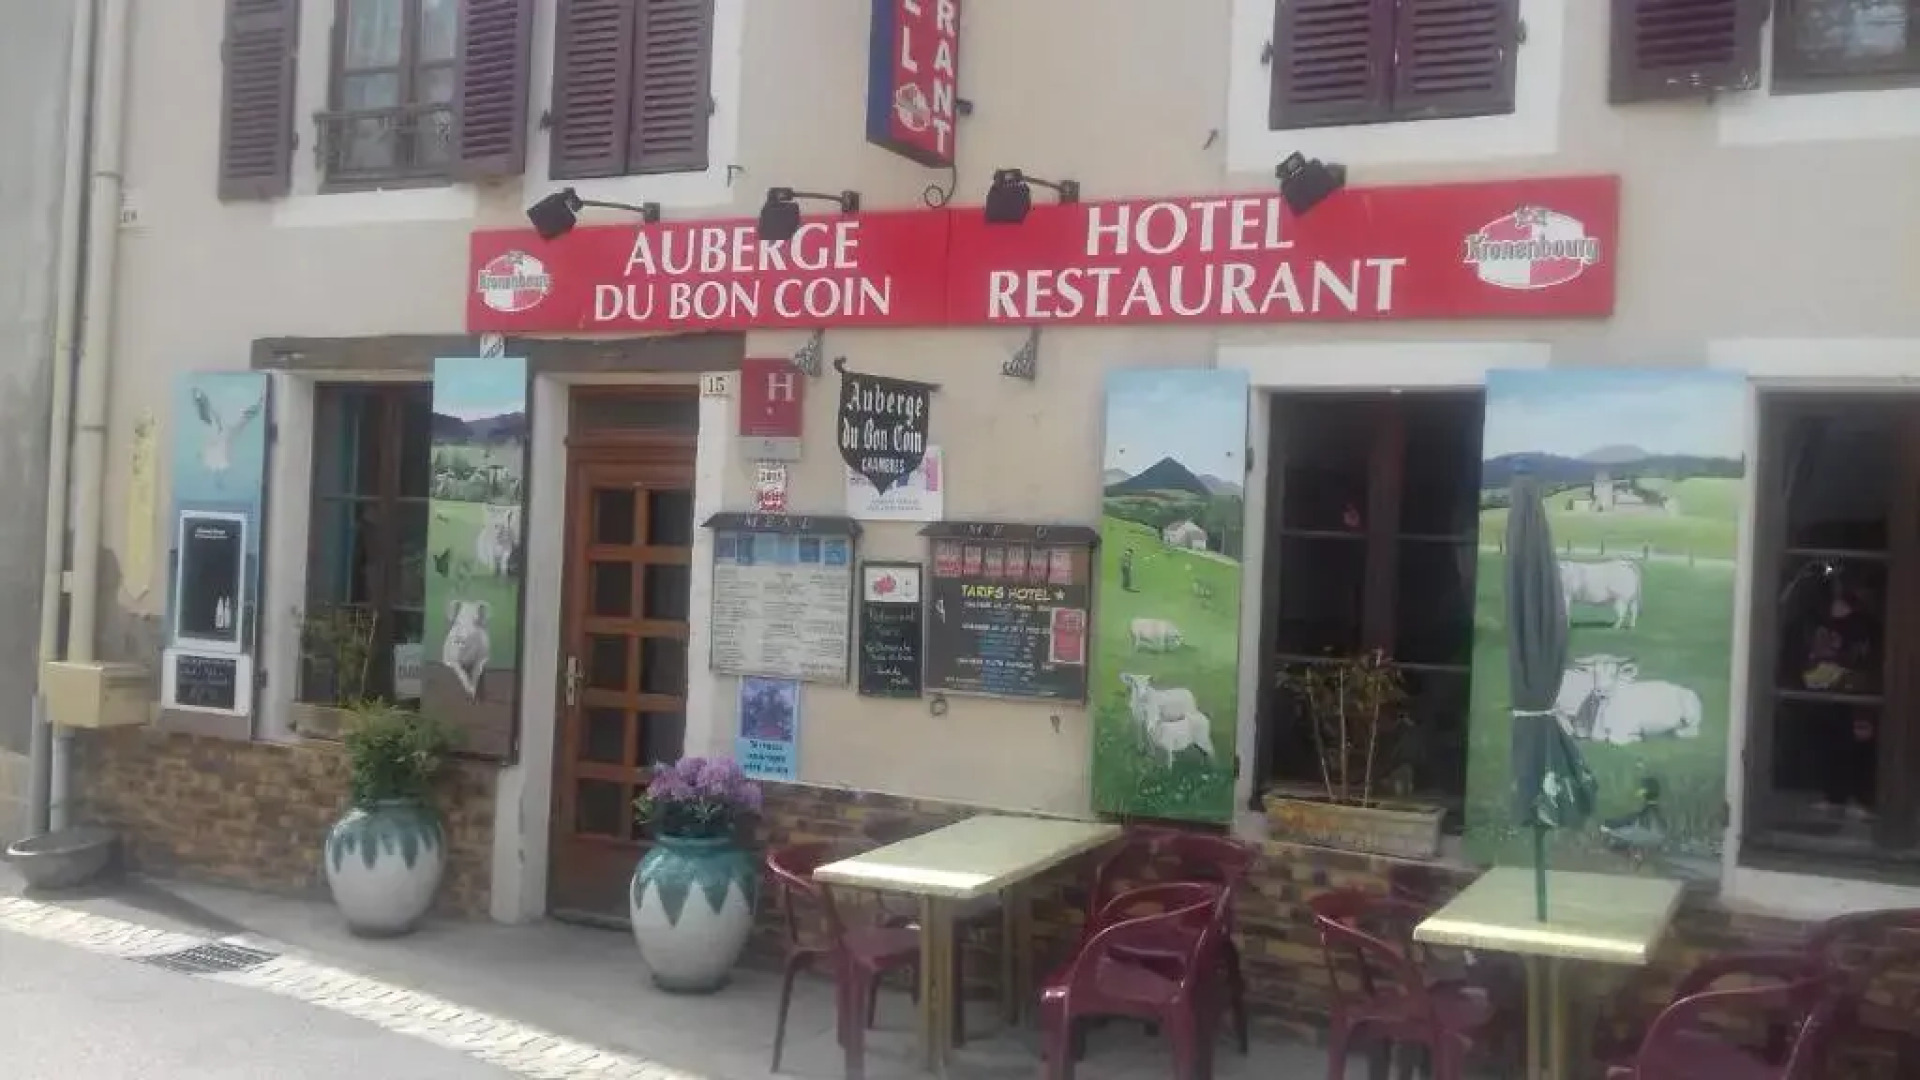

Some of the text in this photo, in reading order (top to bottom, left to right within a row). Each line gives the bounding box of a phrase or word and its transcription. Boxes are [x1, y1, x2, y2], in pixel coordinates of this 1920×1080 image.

[623, 221, 861, 277] AUBERGE
[1086, 197, 1296, 257] HOTEL
[594, 275, 891, 321] DU BON COIN
[987, 256, 1407, 319] RESTAURANT
[709, 376, 725, 393] 15
[768, 372, 796, 402] H
[847, 381, 923, 427] Auberge
[863, 417, 888, 451] Bon
[893, 423, 922, 454] Coin
